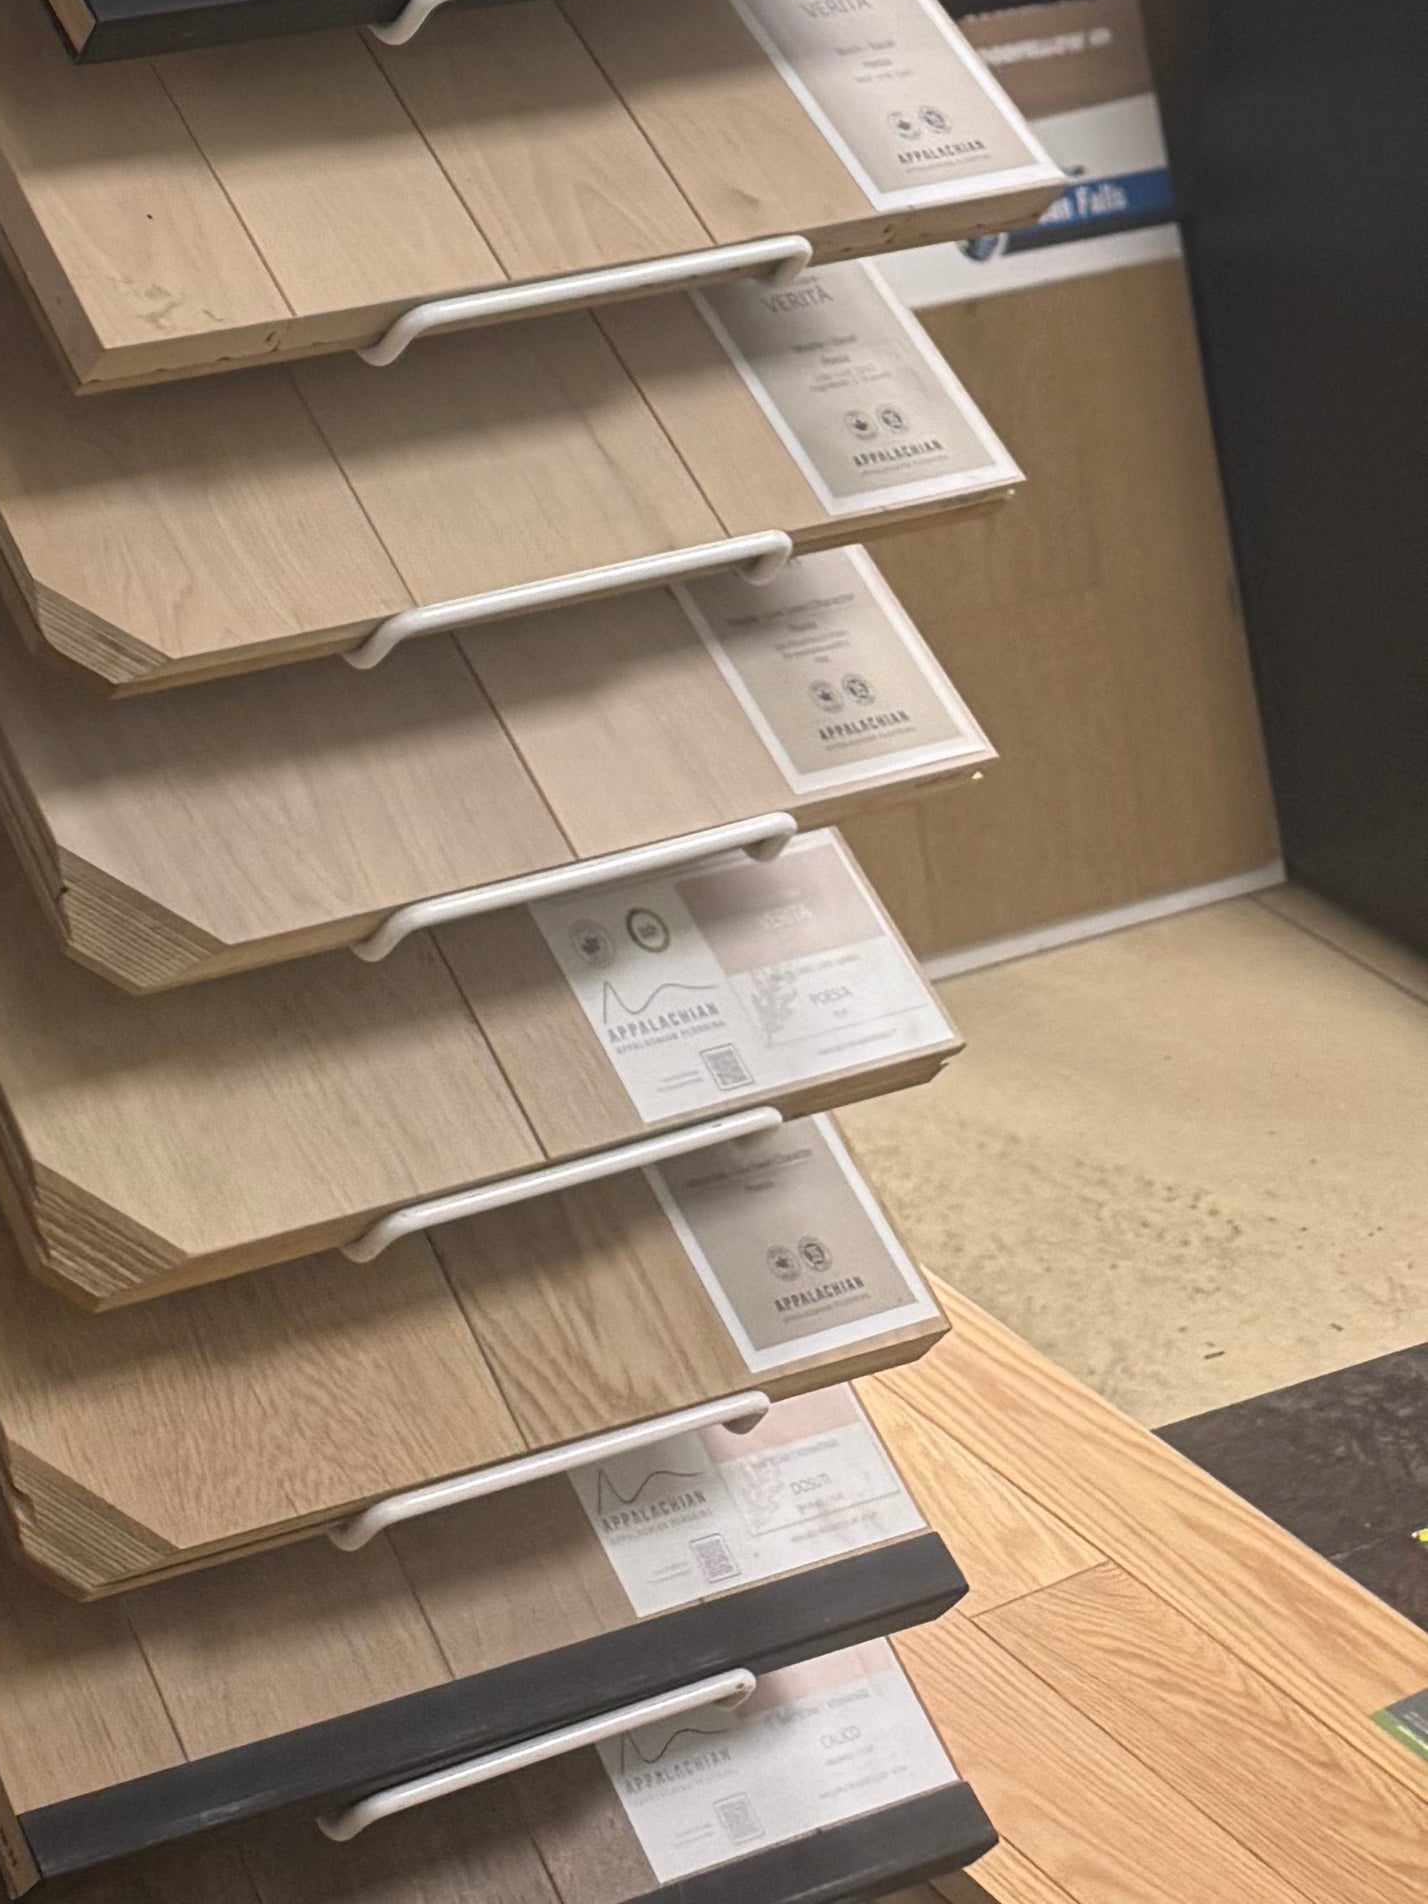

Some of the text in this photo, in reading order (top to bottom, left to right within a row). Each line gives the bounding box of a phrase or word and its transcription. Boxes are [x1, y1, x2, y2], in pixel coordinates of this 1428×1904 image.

[897, 139, 986, 164] APPALACHIAN
[853, 439, 943, 468] APPALACHIAN
[819, 709, 911, 742] APPALACHIAN
[606, 1002, 722, 1043] APPALACHIAN
[773, 1276, 865, 1313] APPALACHIAN
[602, 1489, 708, 1533] APPALACHIAN
[627, 1748, 733, 1791] APPALACHIAN
